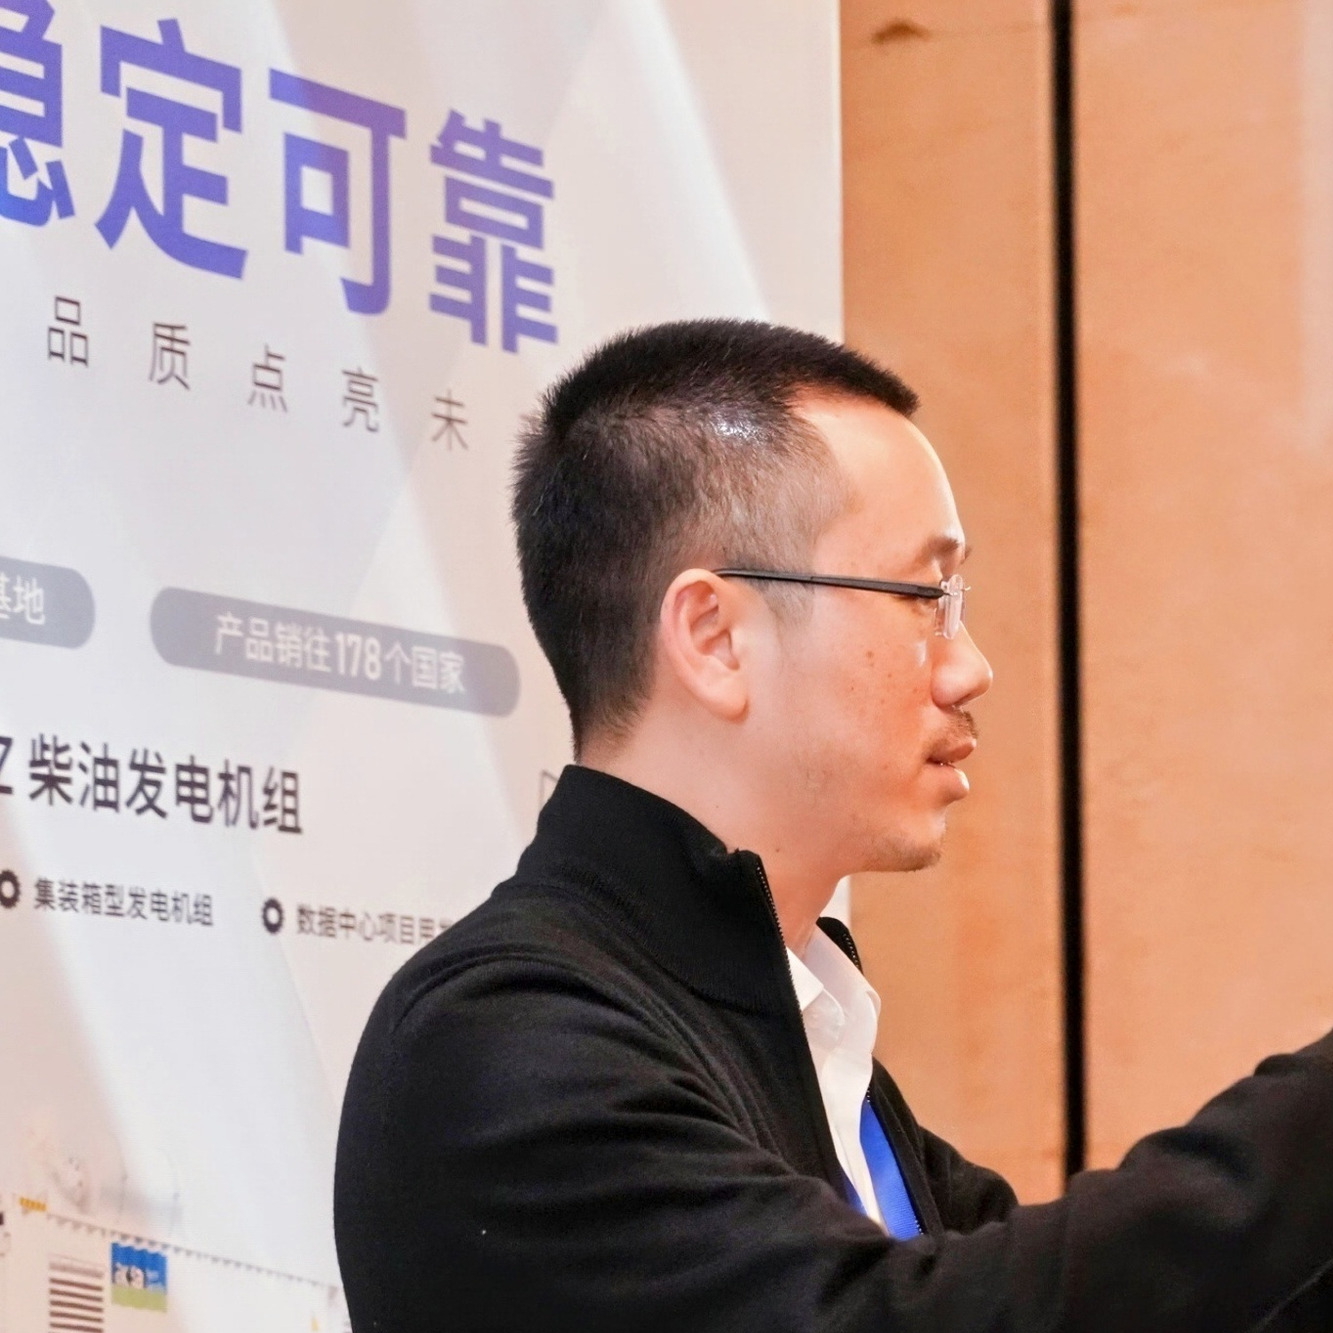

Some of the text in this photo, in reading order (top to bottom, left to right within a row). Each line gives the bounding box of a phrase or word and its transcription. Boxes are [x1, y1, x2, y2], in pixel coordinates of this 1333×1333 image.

[47, 295, 545, 453] 品质点亮未
[215, 611, 466, 694] 产品销往178个国家
[29, 733, 302, 834] 柴油发电机组
[34, 877, 213, 926] 集装箱型发电机组
